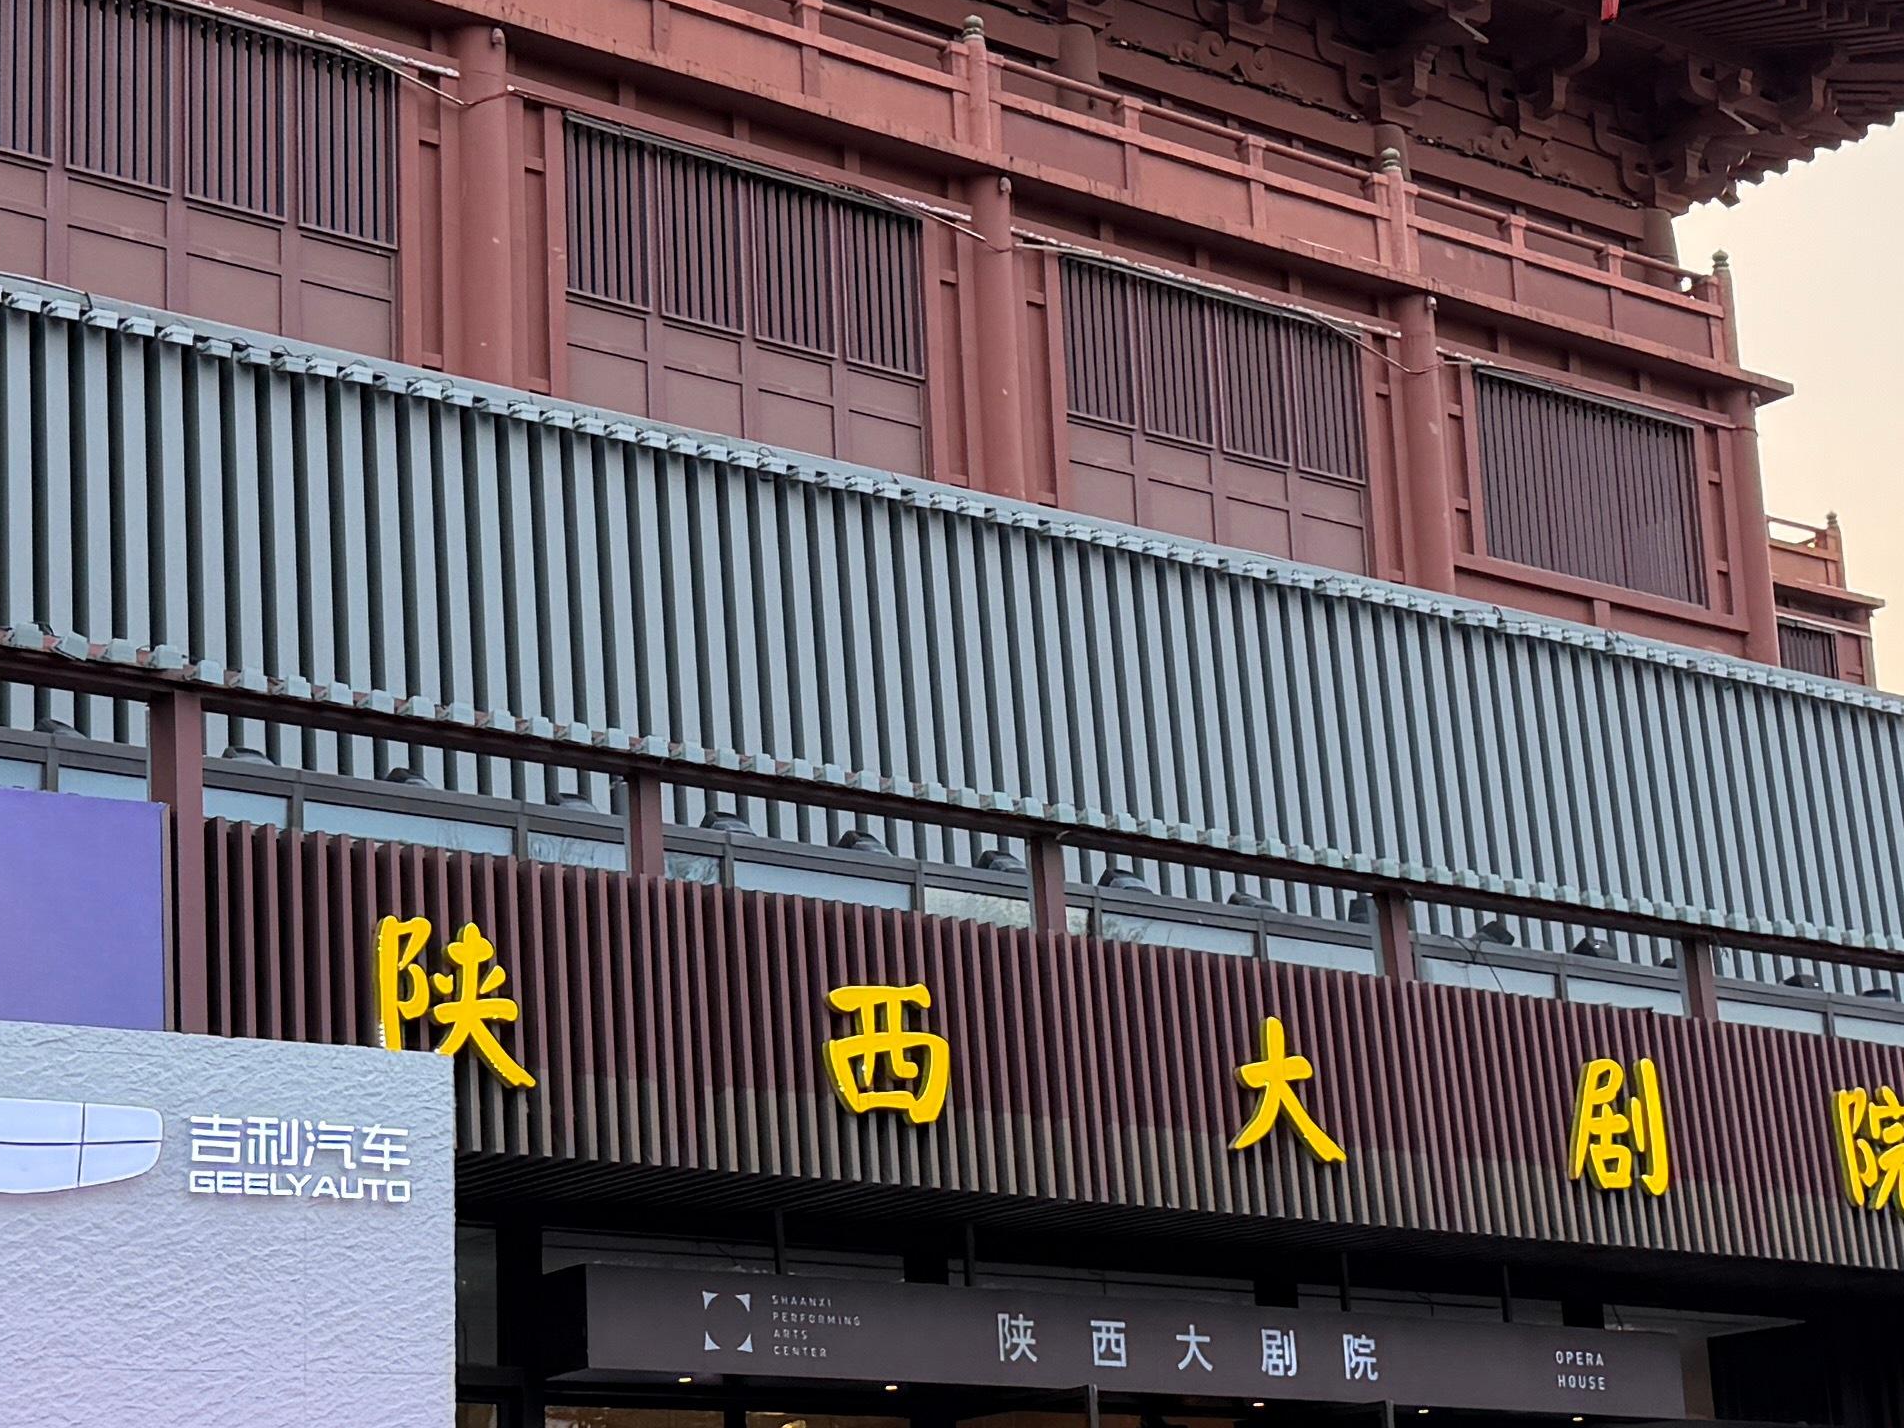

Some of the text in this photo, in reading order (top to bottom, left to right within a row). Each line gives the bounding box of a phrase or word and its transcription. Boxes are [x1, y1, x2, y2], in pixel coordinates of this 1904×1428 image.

[189, 1113, 412, 1172] 吉利汽车
[771, 1294, 832, 1308] SHAANXI
[772, 1311, 861, 1326] PERFORMING
[773, 1328, 808, 1341] ARTS
[773, 1345, 827, 1358] CENTER
[996, 1312, 1380, 1382] 陕西大剧院
[1555, 1350, 1605, 1366] OPERA
[1557, 1374, 1606, 1391] HOUSE
